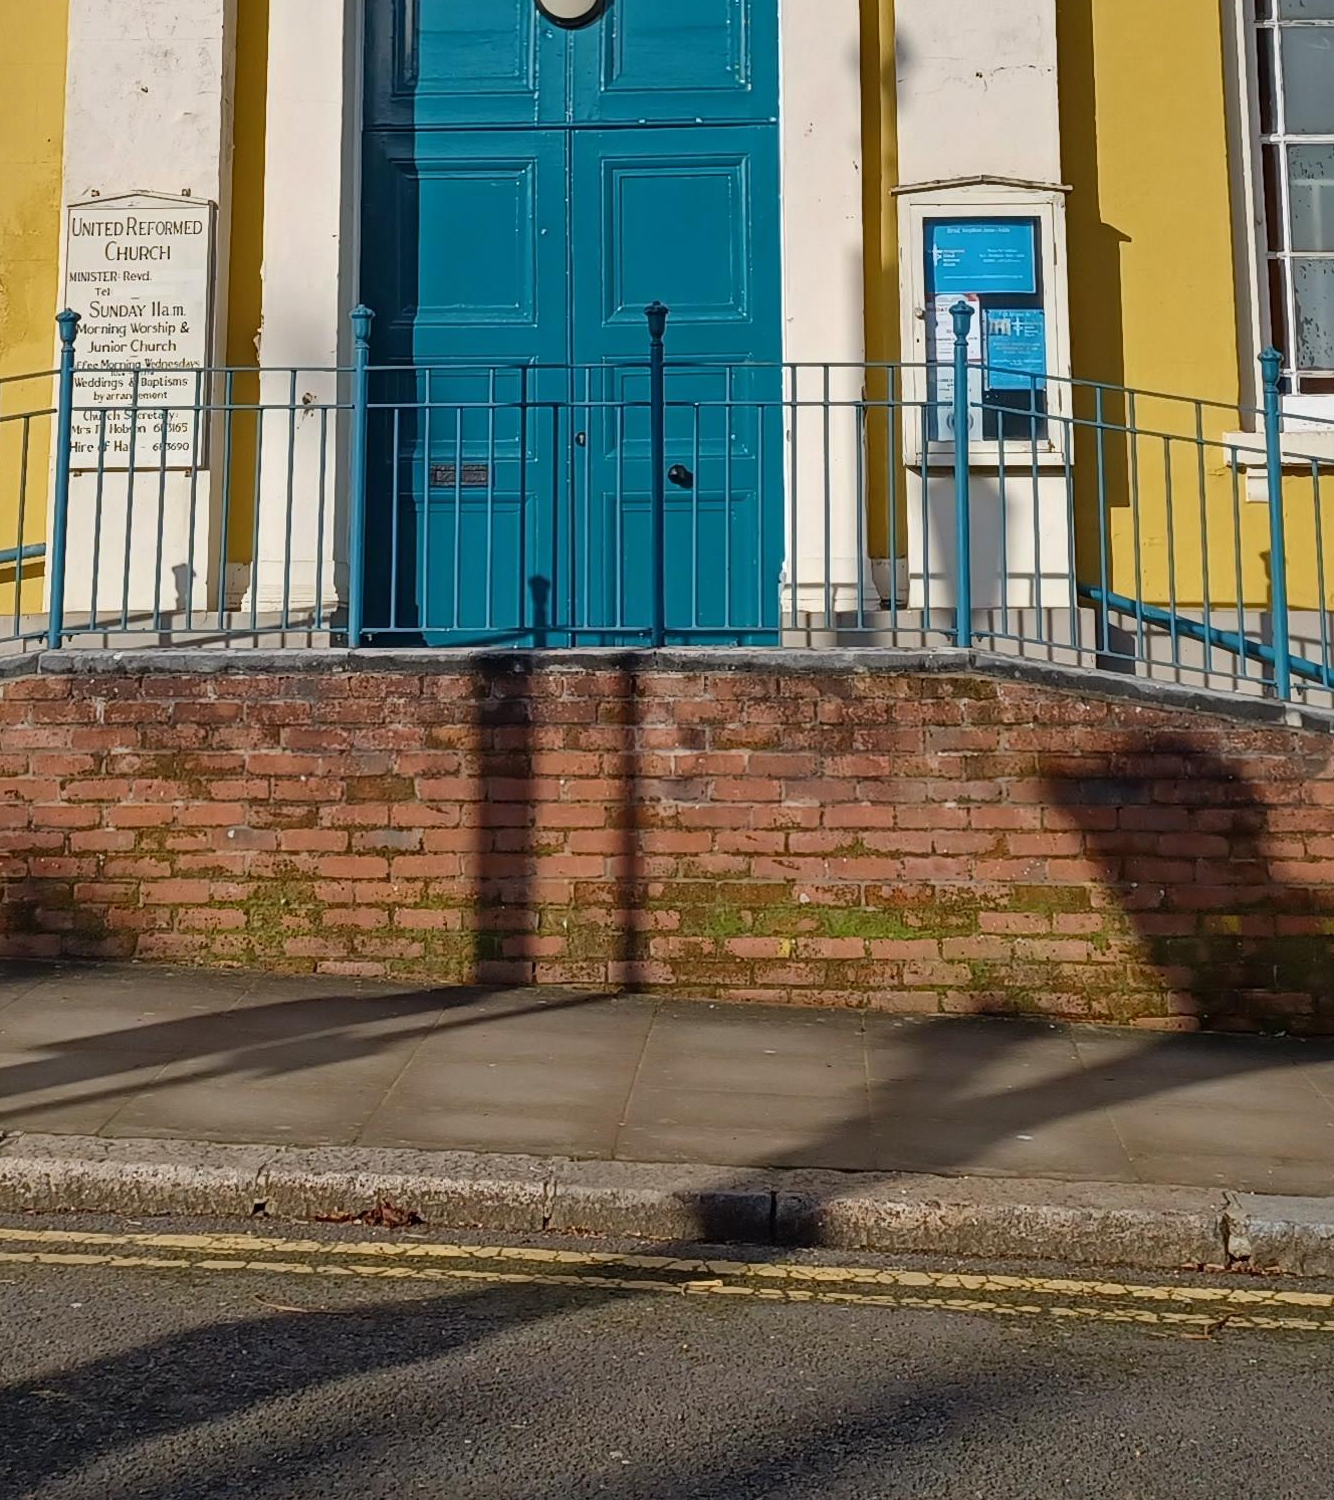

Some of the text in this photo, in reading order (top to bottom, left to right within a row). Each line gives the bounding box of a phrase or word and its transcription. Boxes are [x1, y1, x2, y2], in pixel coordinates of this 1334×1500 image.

[72, 216, 203, 237] UNITED REFORMED
[105, 240, 171, 261] CHURCH
[89, 300, 146, 318] SUNDAY
[75, 321, 190, 338] Morning Worship &
[87, 339, 177, 354] Junior Church
[74, 377, 124, 390] Weddings
[141, 376, 189, 389] Baptisms
[93, 391, 167, 403] by arranement
[83, 409, 120, 421] Chuch
